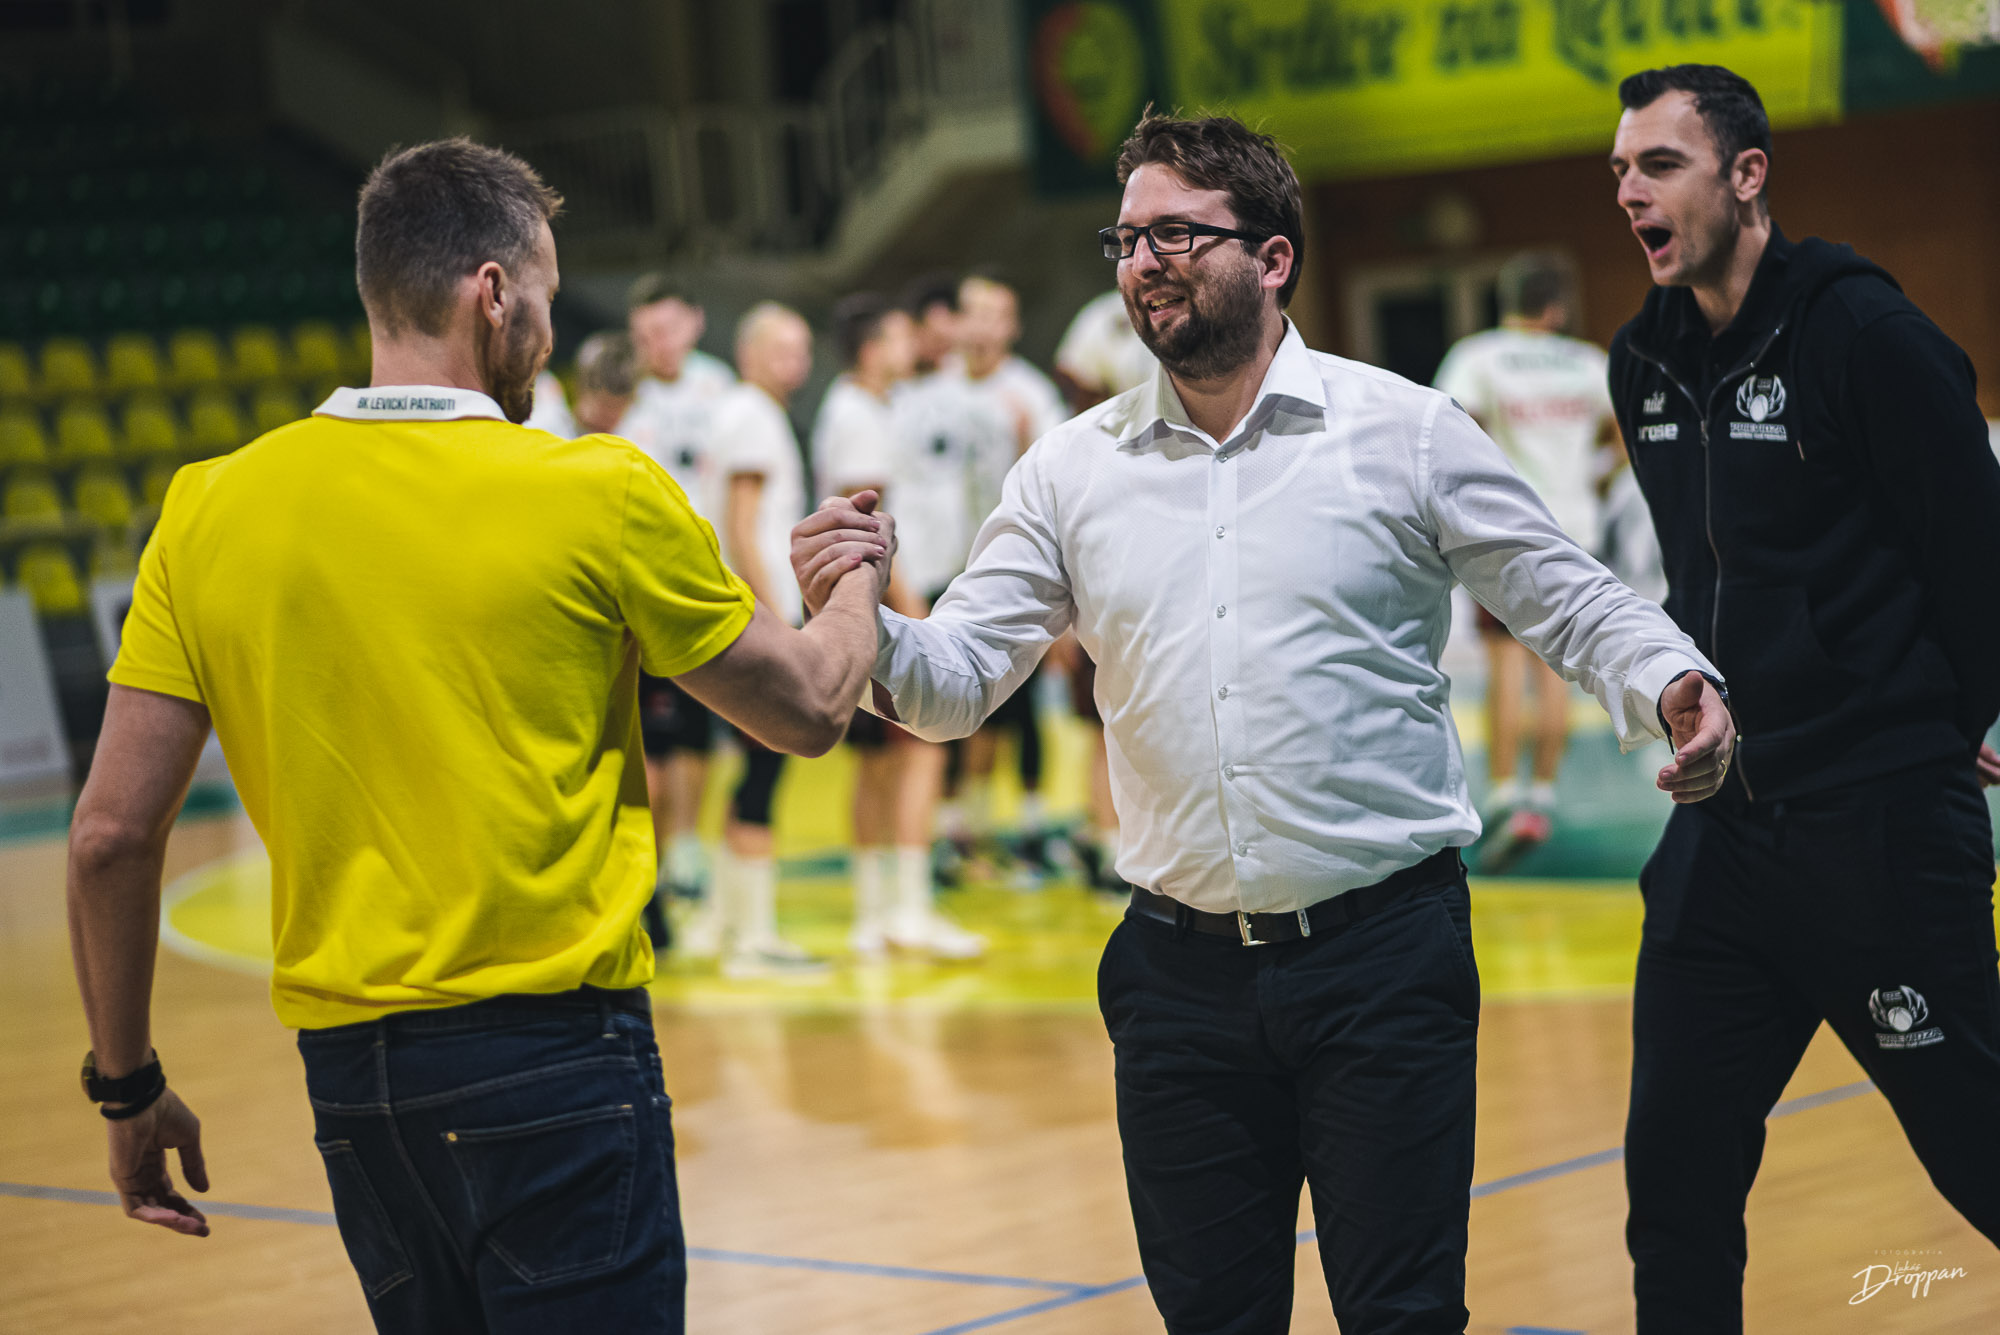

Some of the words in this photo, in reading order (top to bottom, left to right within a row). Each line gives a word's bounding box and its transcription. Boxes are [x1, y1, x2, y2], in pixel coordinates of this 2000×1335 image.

[357, 397, 369, 409] BK
[370, 395, 408, 410] LEVICKÍ
[409, 397, 456, 411] PATRIOTI
